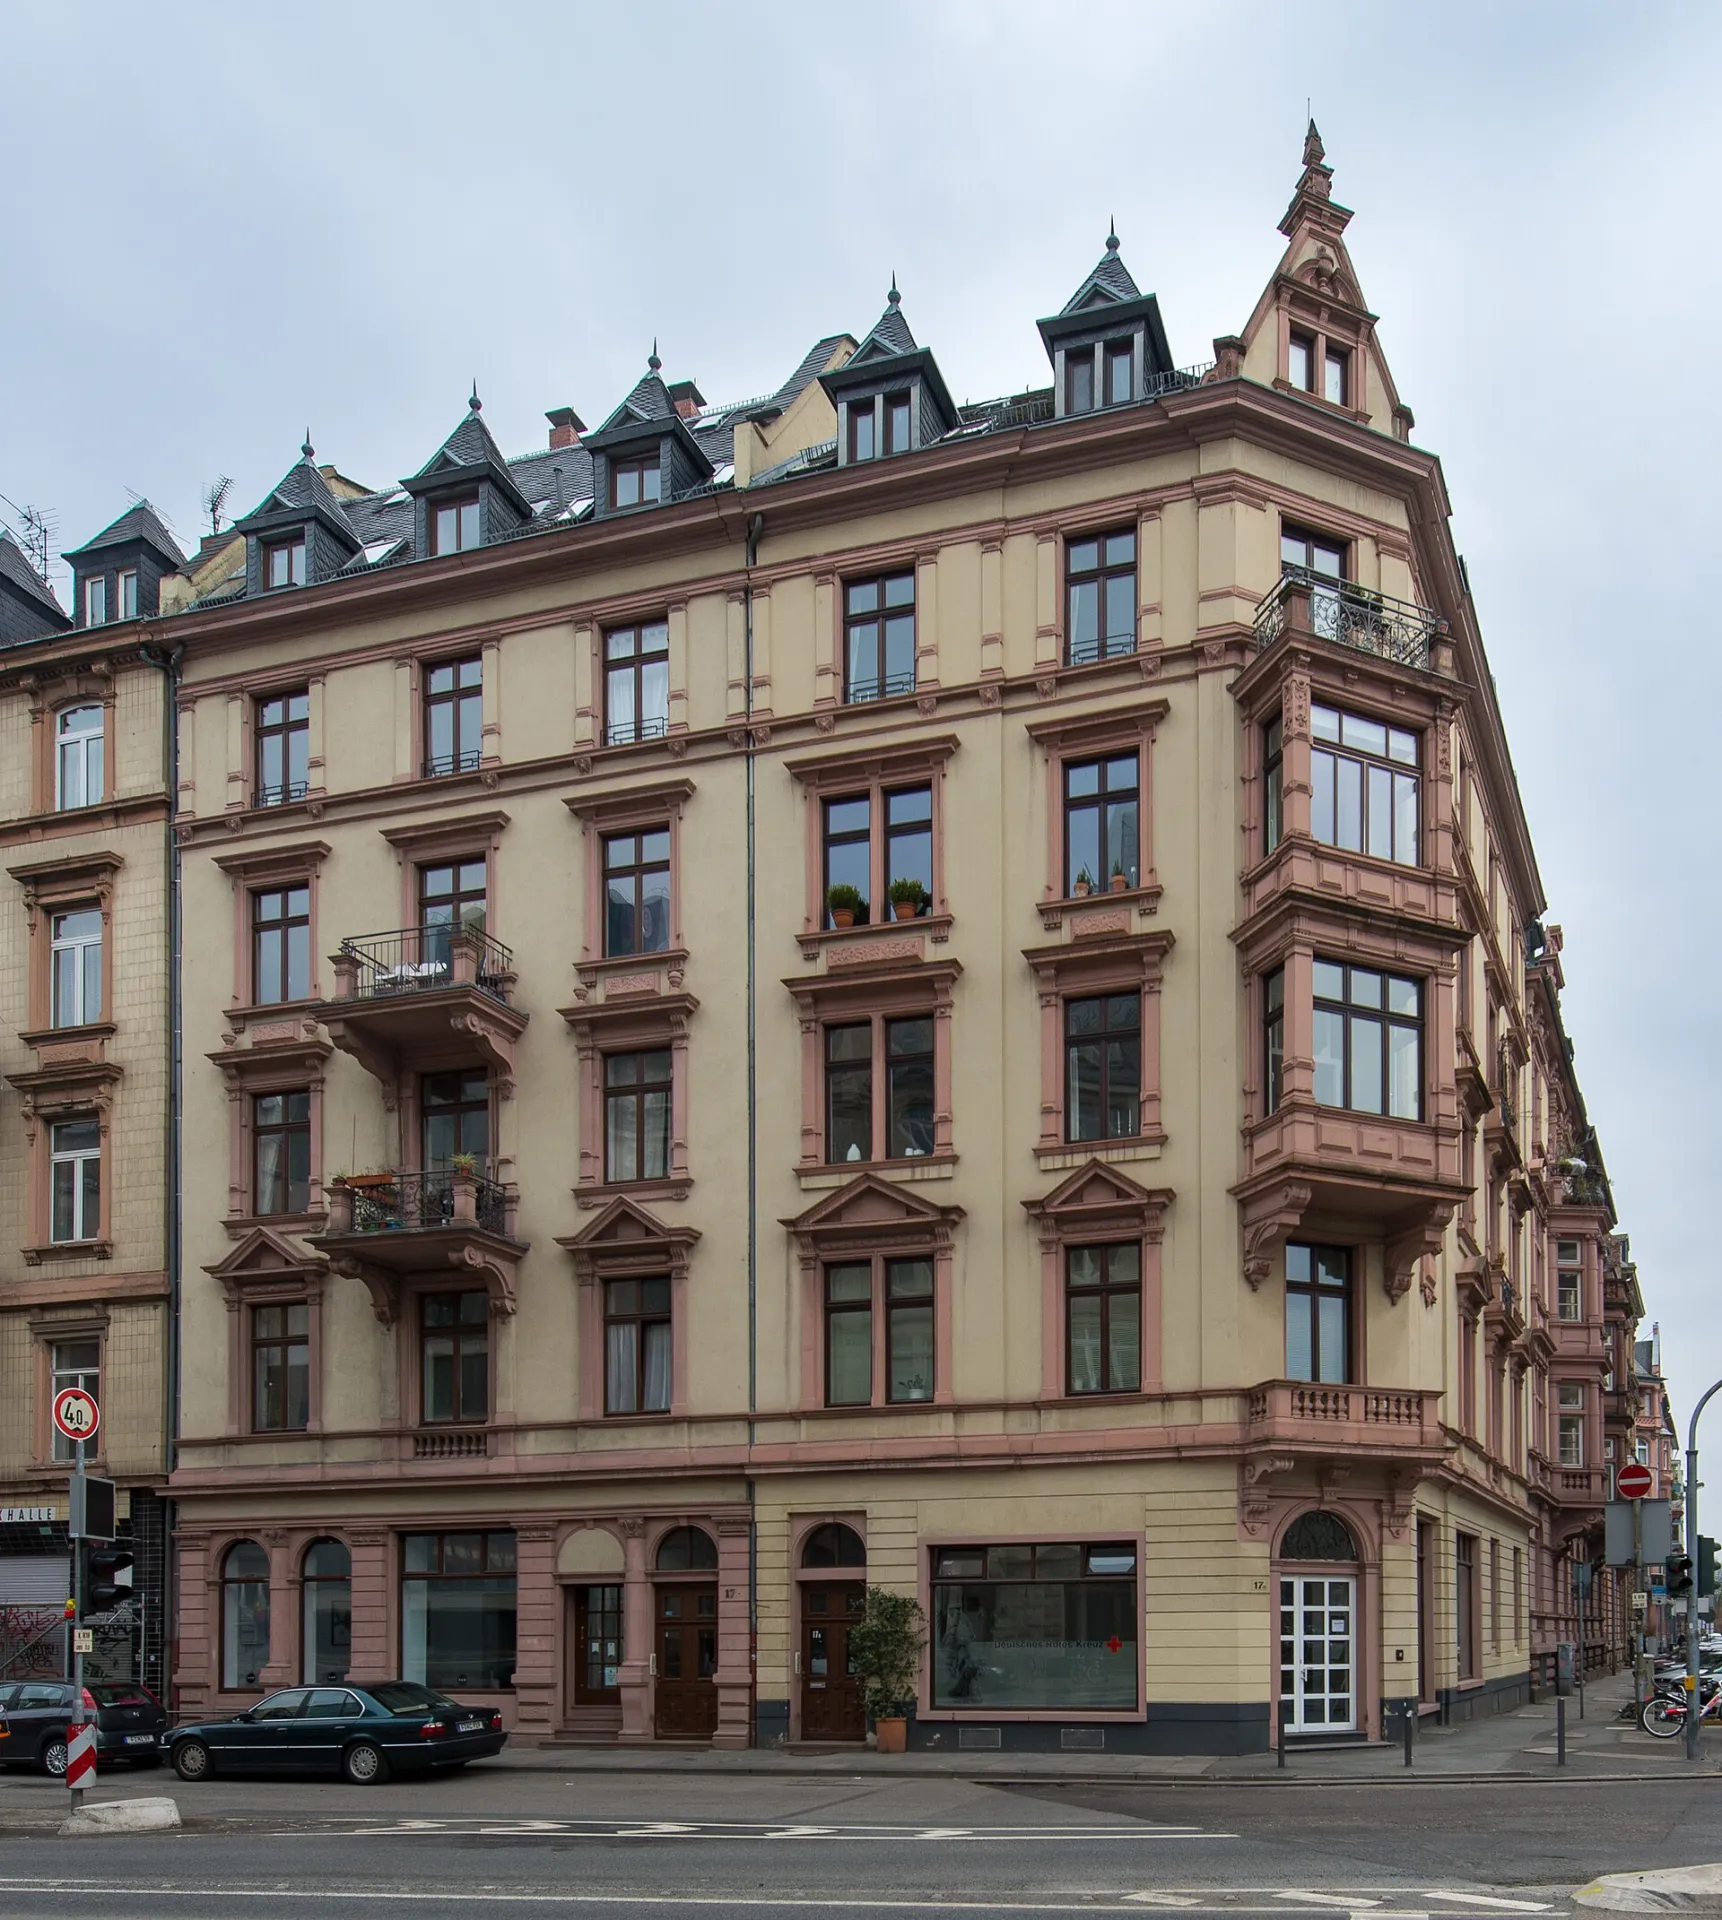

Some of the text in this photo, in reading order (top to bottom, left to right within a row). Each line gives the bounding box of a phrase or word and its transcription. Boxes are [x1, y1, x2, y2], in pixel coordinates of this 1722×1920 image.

[725, 1588, 735, 1599] 17
[994, 1639, 1103, 1649] Deutsches Rotes Kreuz
